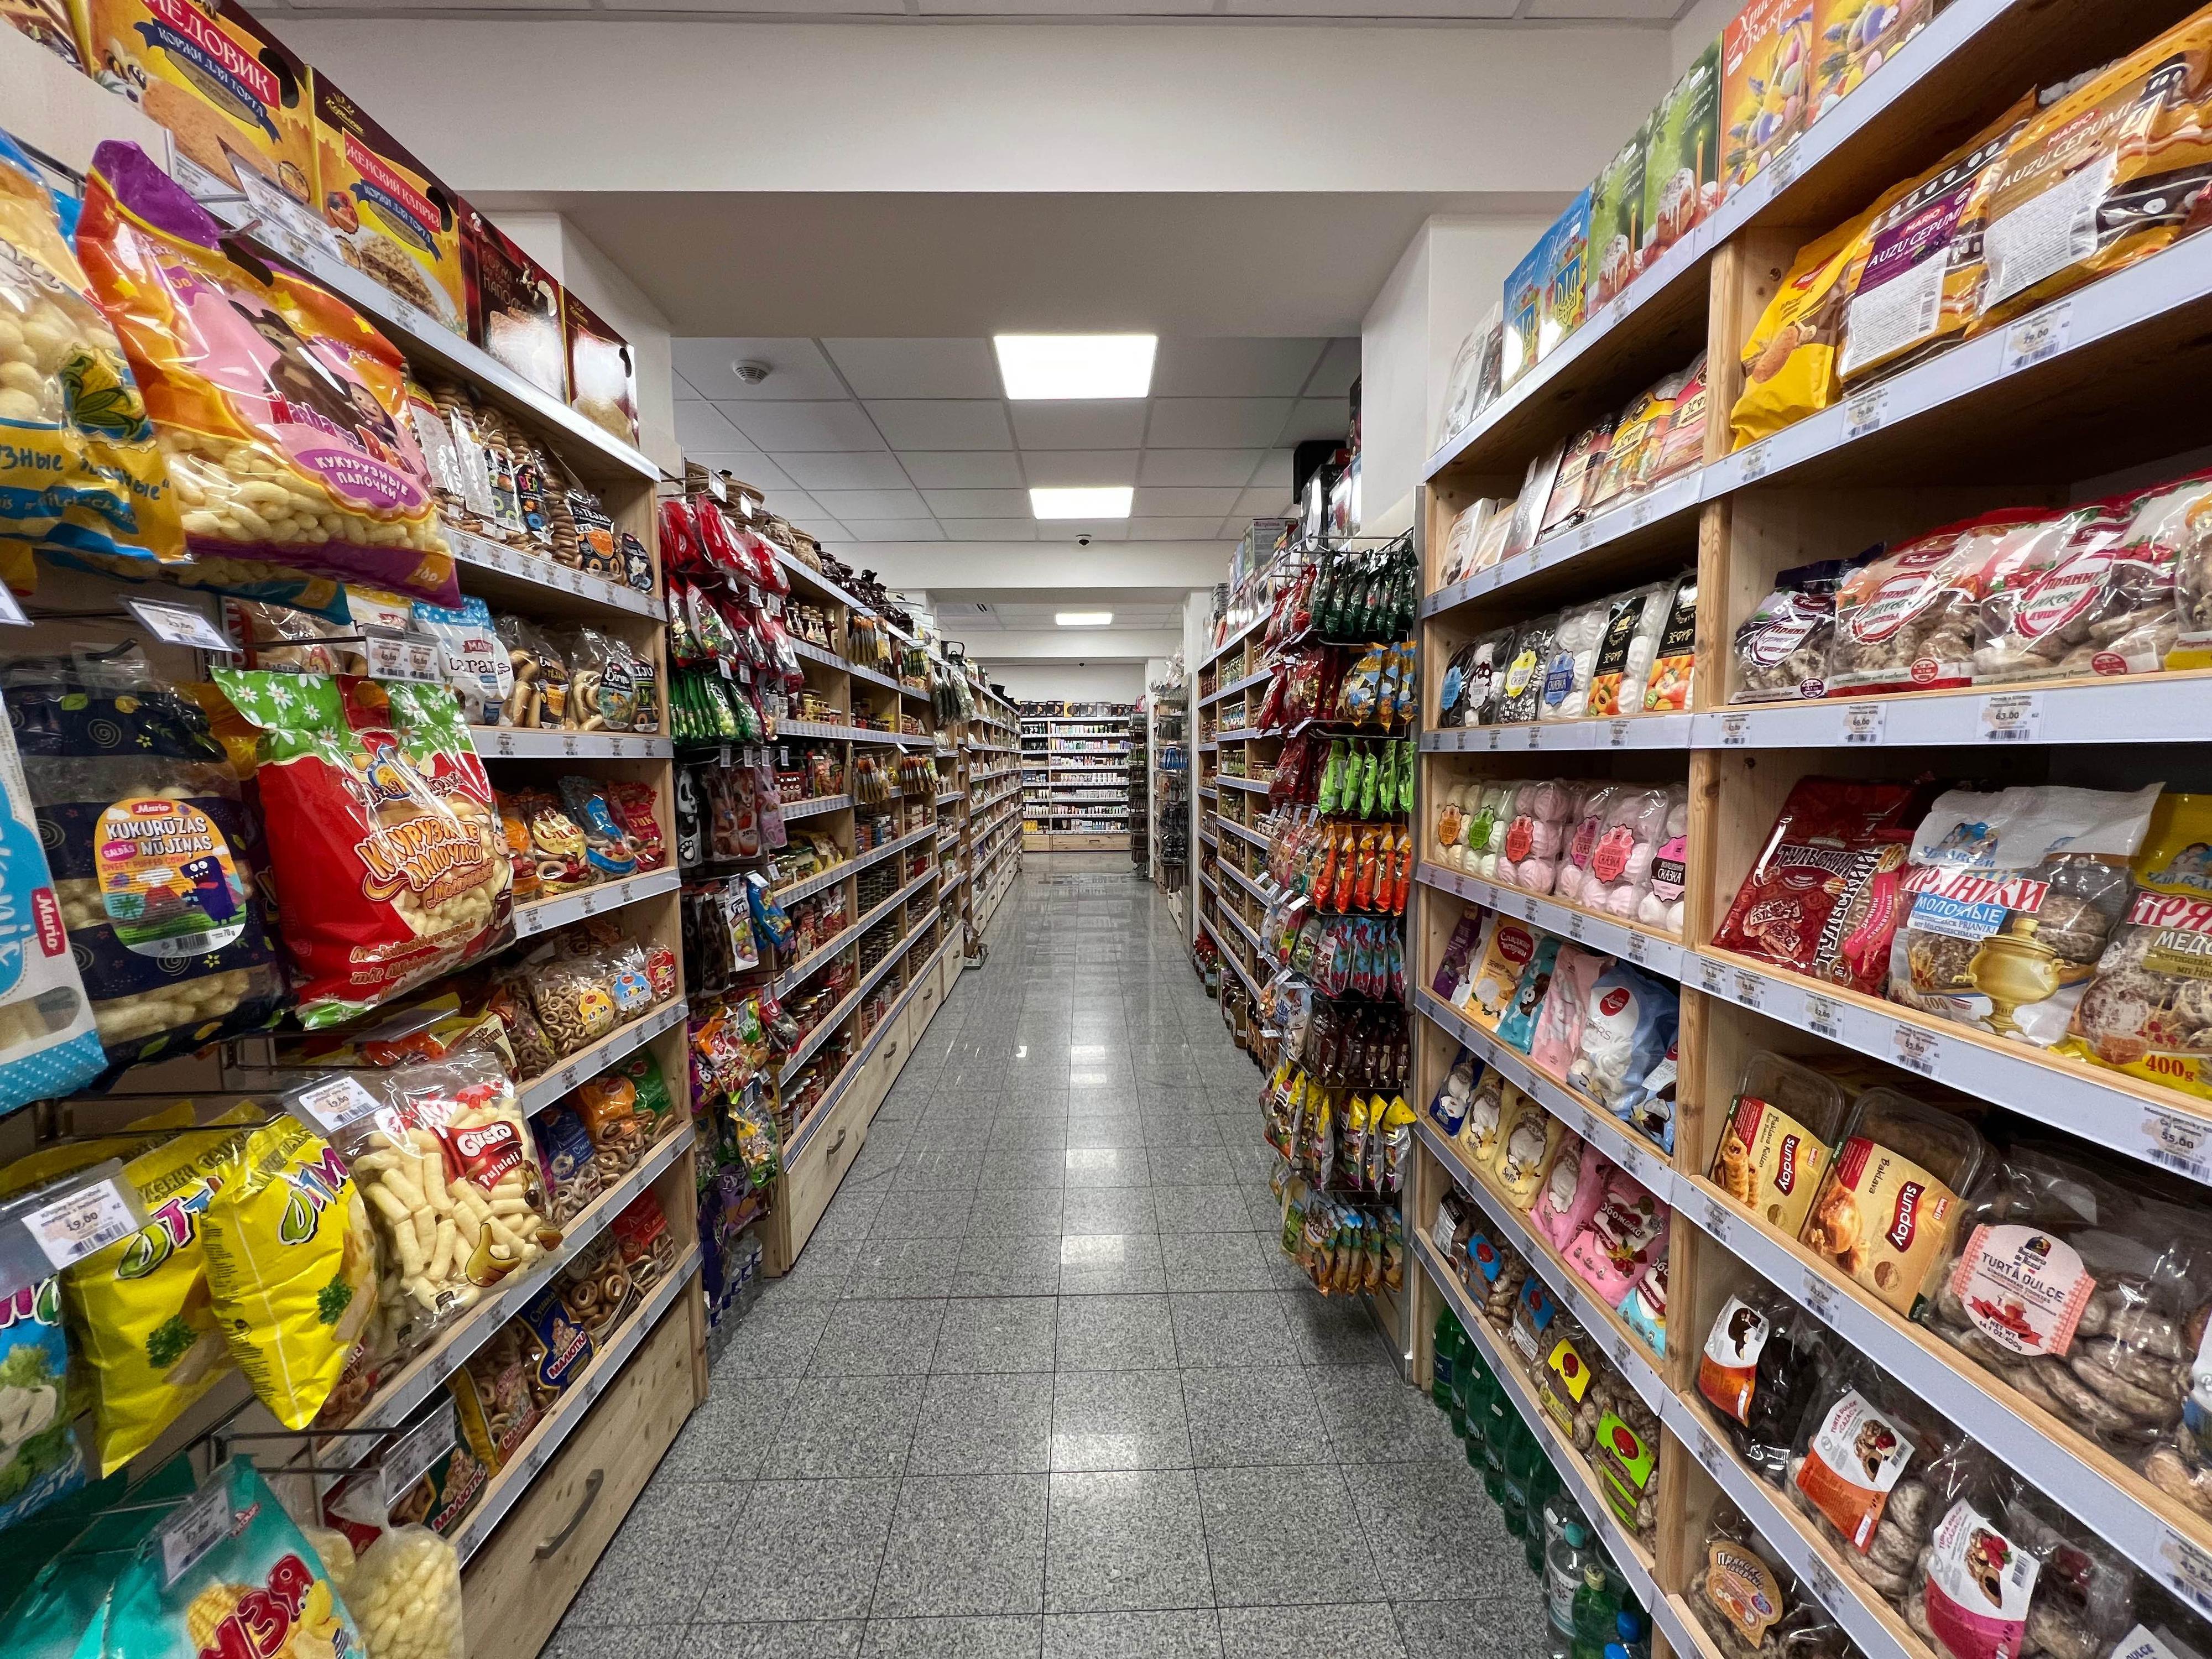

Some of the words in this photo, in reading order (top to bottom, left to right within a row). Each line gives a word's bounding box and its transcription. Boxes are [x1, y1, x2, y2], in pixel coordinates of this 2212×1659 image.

[205, 58, 228, 85] ДЛЯ
[232, 80, 264, 117] ТОРТА
[2047, 111, 2095, 144] MARIO
[1998, 150, 2052, 192] AUZU
[2052, 101, 2131, 166] CEPUMI
[1906, 208, 1941, 232] MARIO
[1867, 234, 1908, 268] AUZU
[1909, 208, 1962, 246] CEPUMI
[314, 456, 408, 496] КУКУРУЗНЫЕ
[336, 471, 397, 500] ПАЛОЧКИ
[577, 525, 592, 534] XXL
[137, 805, 170, 813] Mario
[106, 817, 207, 841] KUKURŪZAS
[103, 845, 135, 858] SALDĀS
[140, 836, 213, 857] NŪJIŅAS
[103, 862, 129, 872] SWEET
[166, 856, 187, 864] CORN
[405, 845, 482, 888] ПАЛОЧКИ
[1658, 868, 1683, 884] СКАЗКА
[35, 896, 57, 950] Mario
[1860, 897, 1880, 930] ПРЯНИК
[351, 968, 384, 984] mit
[457, 1124, 512, 1157] Gusto
[1766, 1114, 1780, 1147] Baklava
[2161, 1131, 2194, 1149] 55,00
[1759, 1146, 1771, 1168] Rollen
[1778, 1137, 1795, 1191] sunday
[1502, 1167, 1517, 1183] Sefir
[1869, 1157, 1890, 1195] Baklava
[66, 1212, 98, 1231] 19,00
[1891, 1185, 1917, 1247] sunday
[2022, 1274, 2065, 1304] DULCE
[1990, 1321, 2003, 1331] NET
[2005, 1329, 2016, 1339] WT
[1839, 1399, 1858, 1415] DULCE
